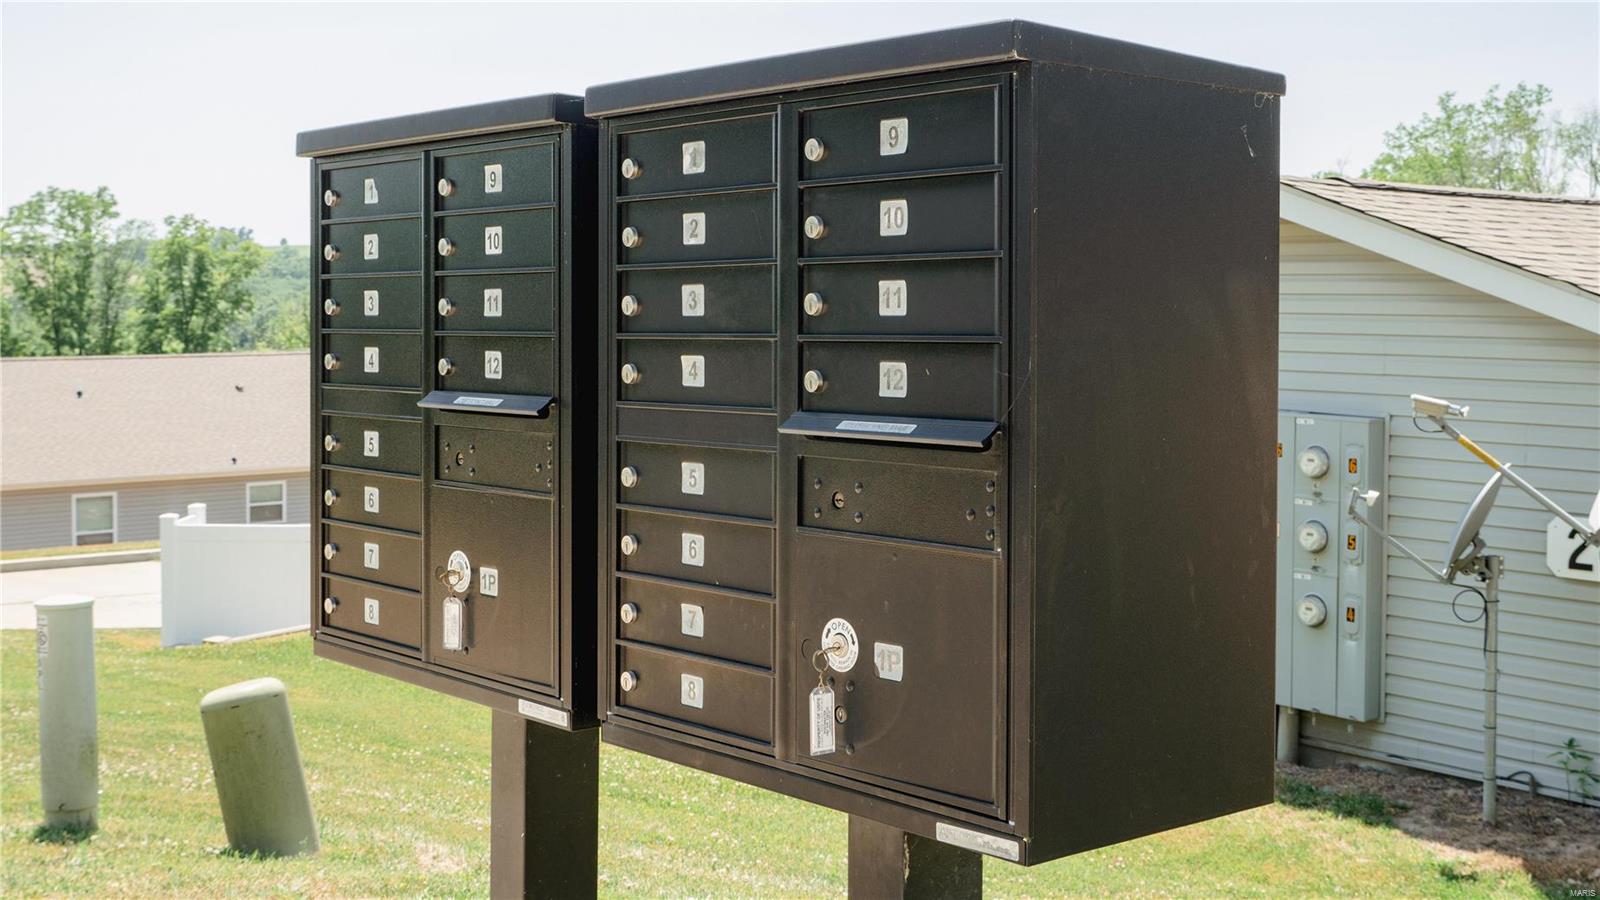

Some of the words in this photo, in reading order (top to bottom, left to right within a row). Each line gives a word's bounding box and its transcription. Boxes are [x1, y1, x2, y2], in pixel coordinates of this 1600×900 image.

[888, 126, 899, 148] 9
[489, 171, 496, 188] 9
[884, 207, 904, 229] 10
[689, 219, 698, 239] 2
[368, 240, 374, 255] 2
[487, 233, 500, 250] 10
[368, 296, 374, 312] 3
[487, 295, 499, 312] 11
[688, 290, 697, 310] 3
[883, 287, 901, 309] 11
[368, 353, 374, 368] 4
[487, 357, 500, 374] 12
[688, 361, 698, 380] 4
[883, 368, 904, 390] 12
[368, 437, 374, 452] 5
[1349, 458, 1357, 473] 6
[688, 469, 697, 488] 5
[368, 493, 374, 508] 6
[689, 540, 697, 559] 6
[1348, 534, 1356, 550] 5
[1568, 528, 1593, 571] 2
[368, 548, 374, 564] 7
[481, 573, 496, 591] 1P
[368, 604, 374, 620] 8
[687, 610, 696, 629] 7
[1346, 607, 1355, 622] 4
[831, 621, 852, 635] OPEN
[879, 650, 900, 672] 1P
[688, 681, 696, 700] 8
